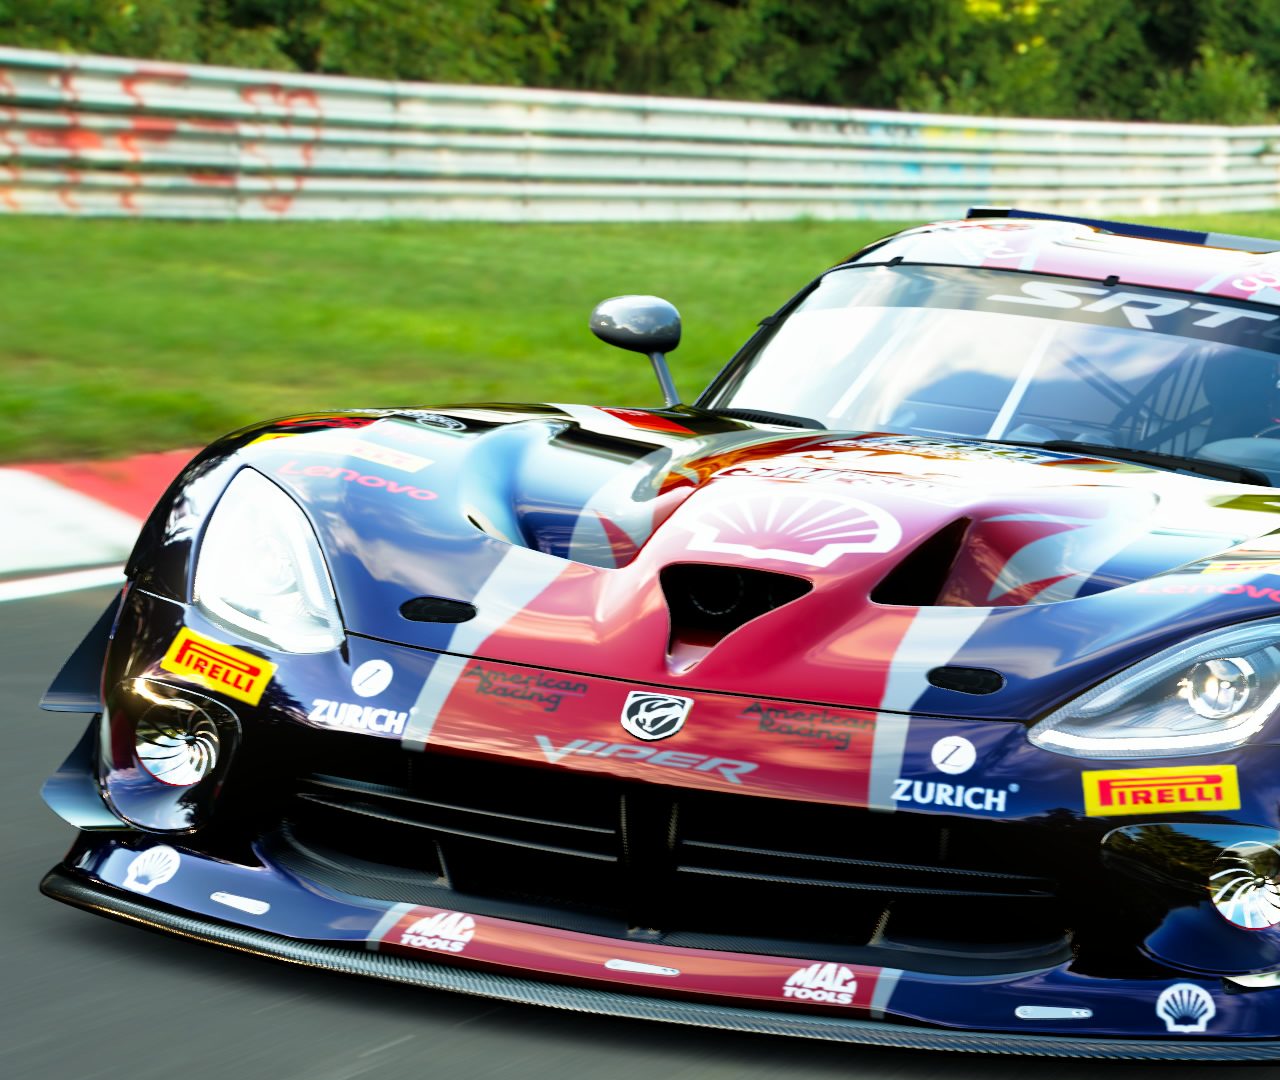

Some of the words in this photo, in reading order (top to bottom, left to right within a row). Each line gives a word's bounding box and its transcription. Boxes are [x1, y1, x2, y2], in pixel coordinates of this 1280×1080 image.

[277, 461, 440, 502] Lenovo
[174, 638, 262, 694] PIRELLI
[464, 664, 589, 694] American
[476, 681, 564, 712] Racing
[742, 701, 878, 732] American
[758, 720, 853, 751] Racing
[534, 734, 760, 785] VIPER
[1097, 774, 1223, 807] PIRELLI
[399, 933, 466, 952] TOOLS
[404, 911, 477, 943] MAC
[784, 963, 858, 995] MAC
[782, 985, 854, 1005] TOOLS
